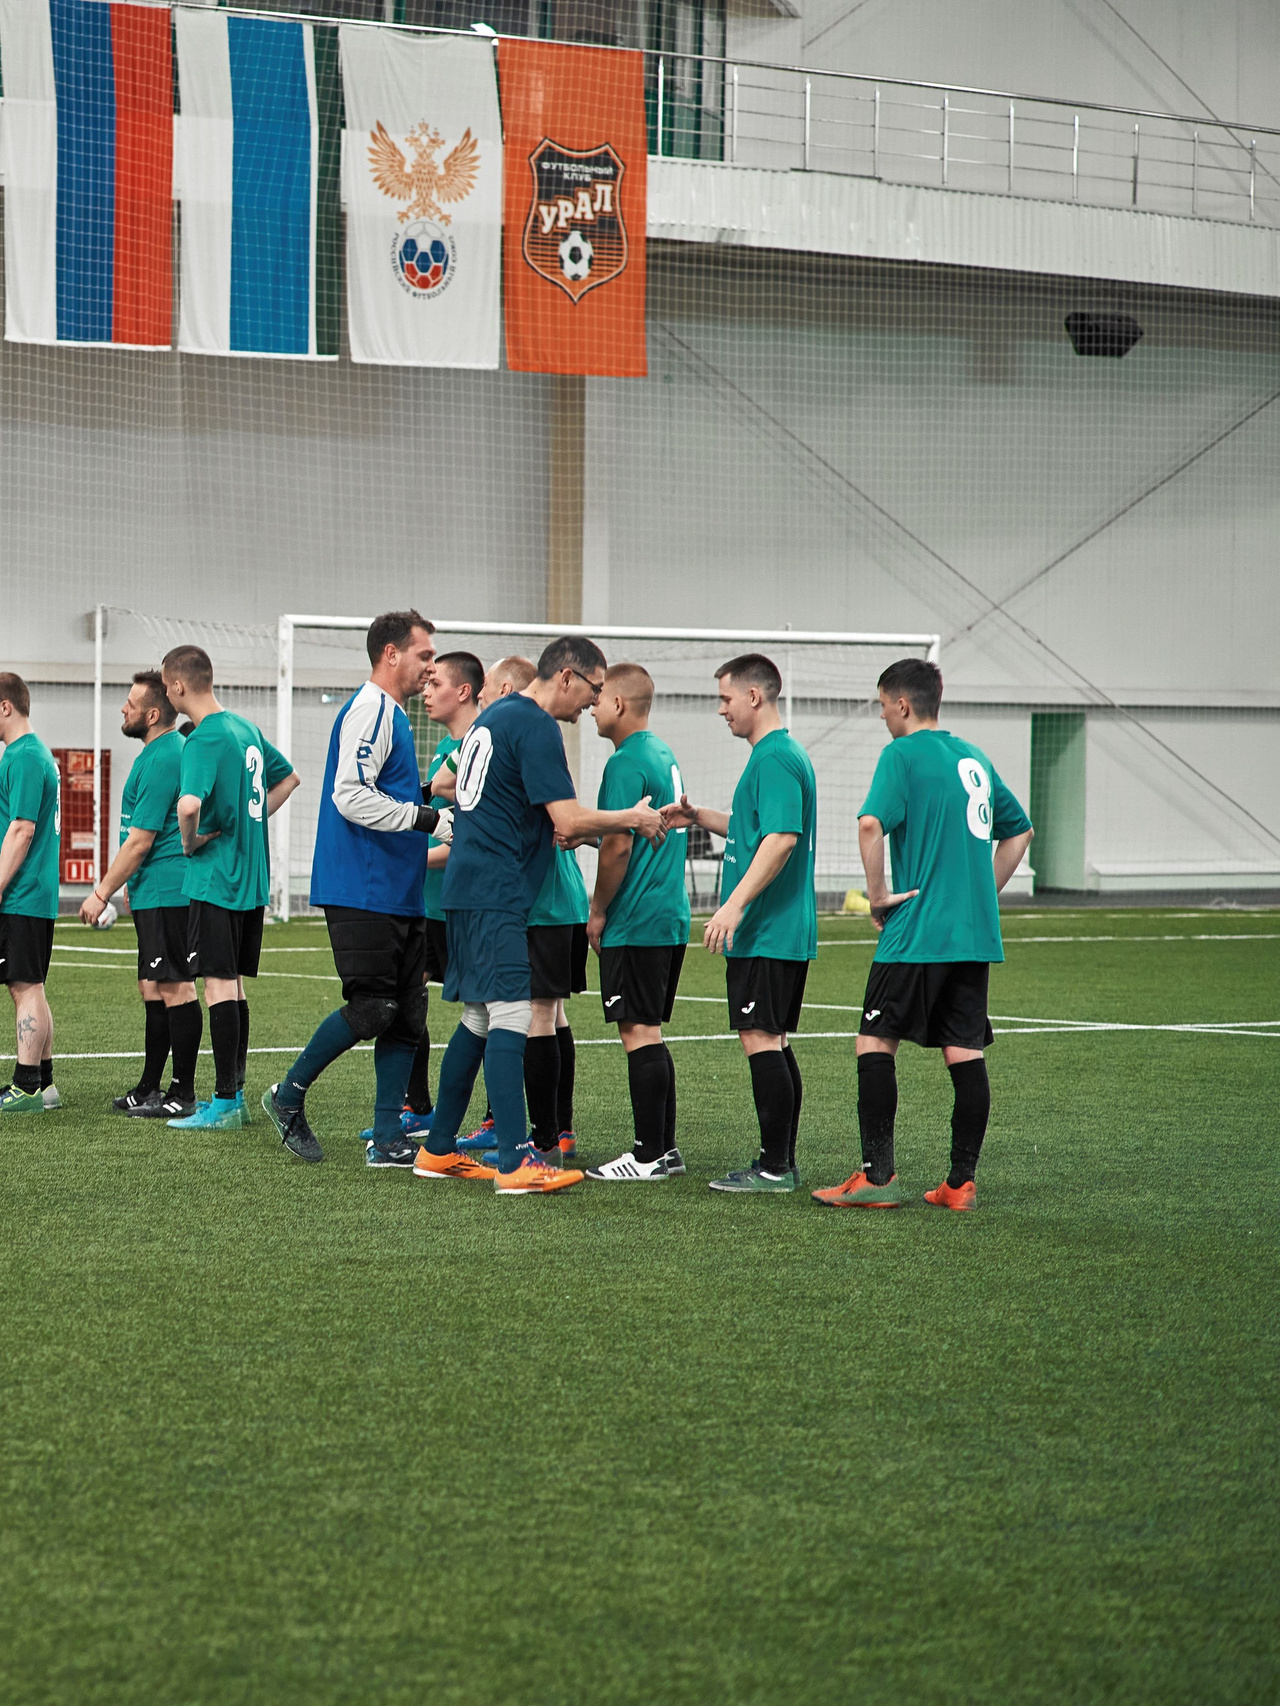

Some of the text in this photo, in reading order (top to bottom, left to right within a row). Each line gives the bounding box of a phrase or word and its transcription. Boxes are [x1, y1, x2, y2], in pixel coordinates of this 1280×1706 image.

[541, 161, 614, 175] ФУТБОЛЬНЫЙ
[563, 172, 592, 182] КЛУБ
[538, 183, 614, 235] УРАЛ
[245, 745, 265, 822] 3
[957, 757, 993, 843] 8
